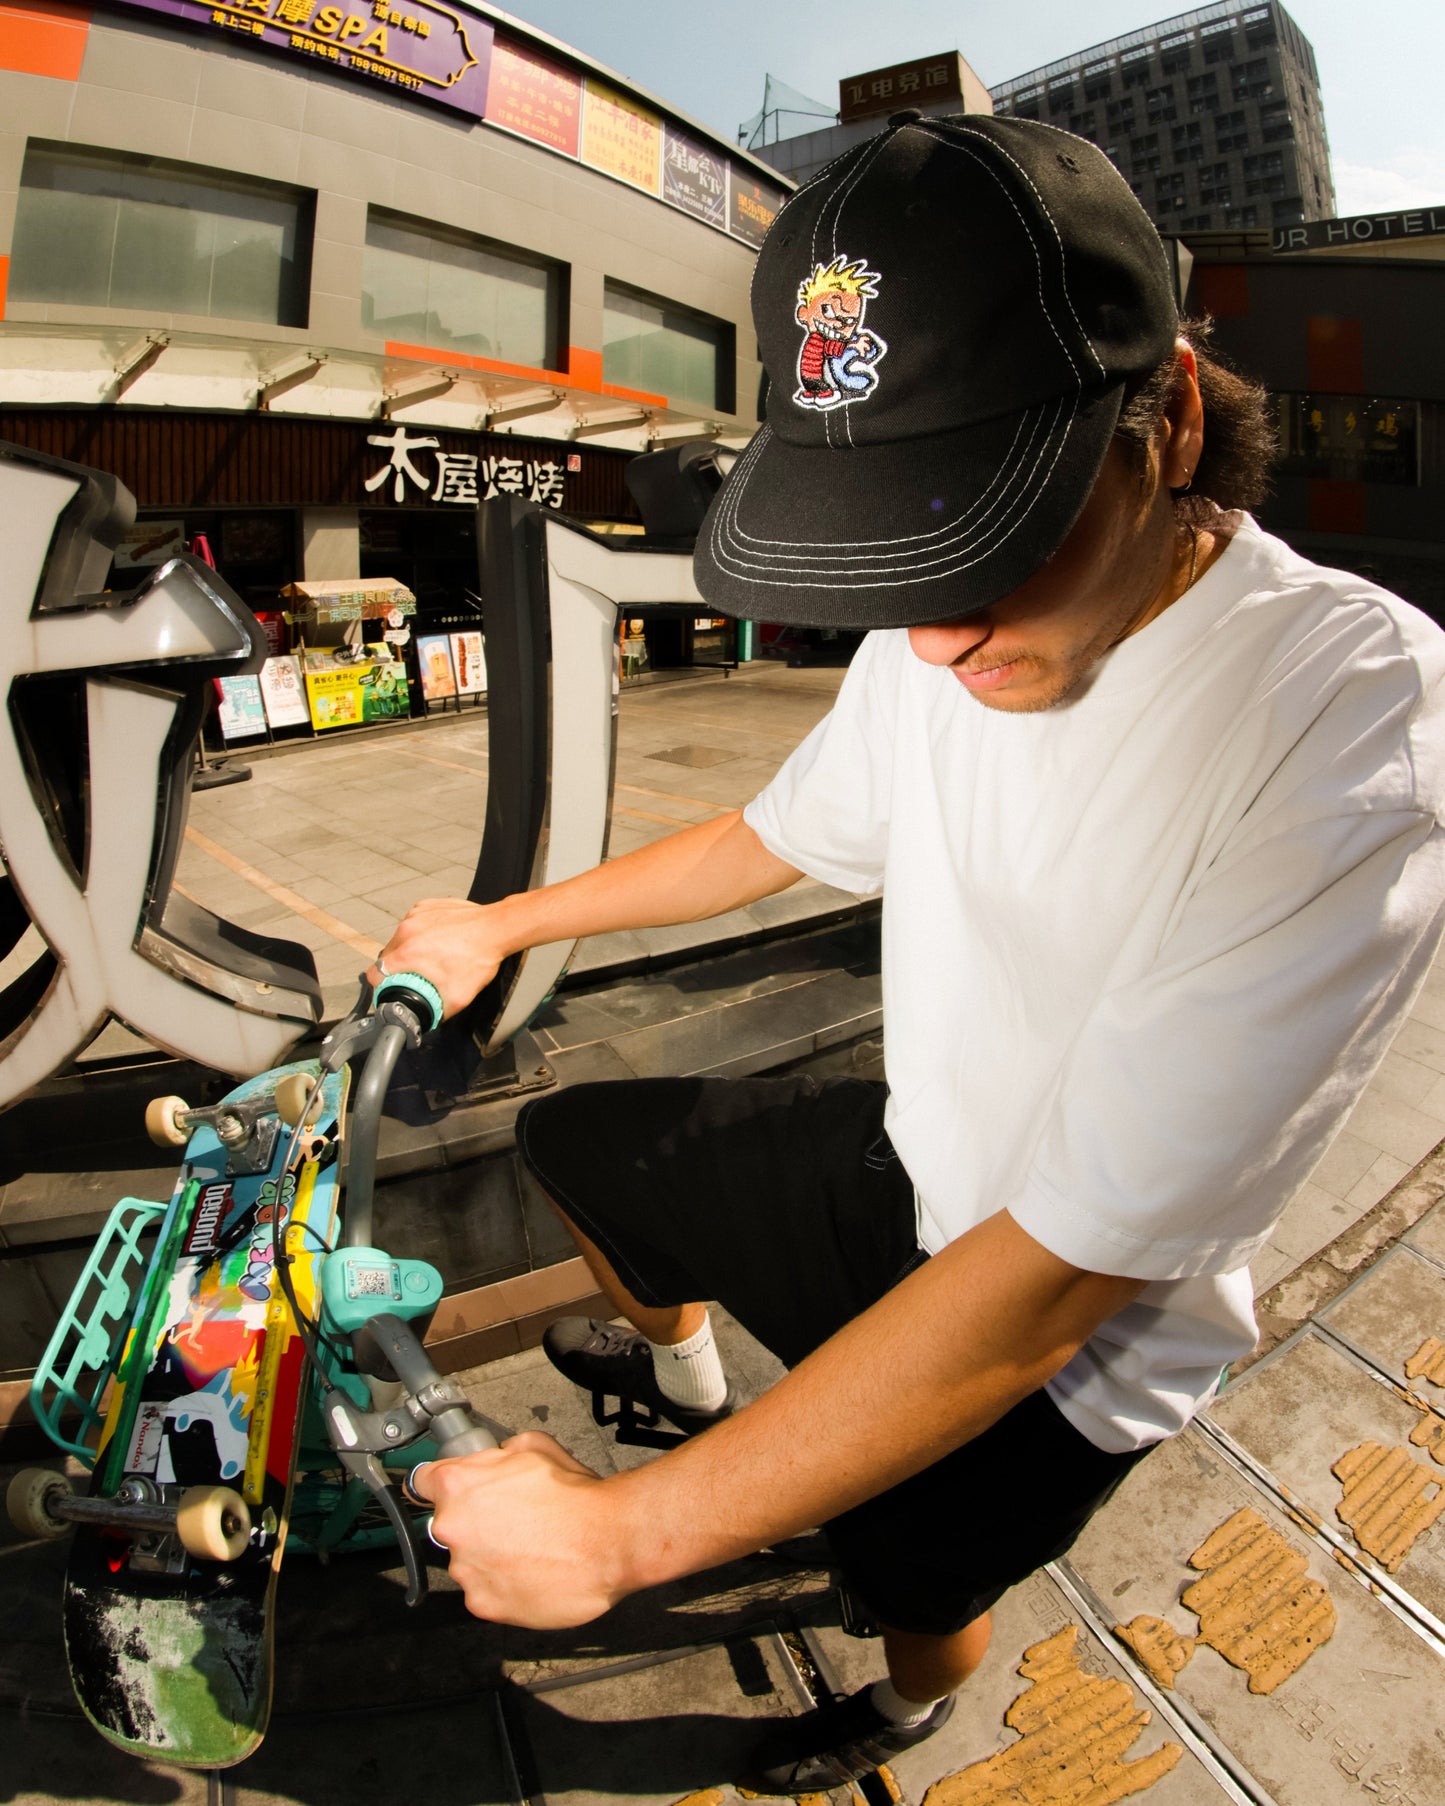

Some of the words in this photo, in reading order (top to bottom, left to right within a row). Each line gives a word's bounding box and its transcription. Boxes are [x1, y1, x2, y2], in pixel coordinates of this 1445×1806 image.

[212, 10, 265, 36] 请上二楼
[364, 426, 565, 509] 木屋烧烤
[189, 1183, 233, 1254] beyond
[132, 1421, 152, 1469] Nando's
